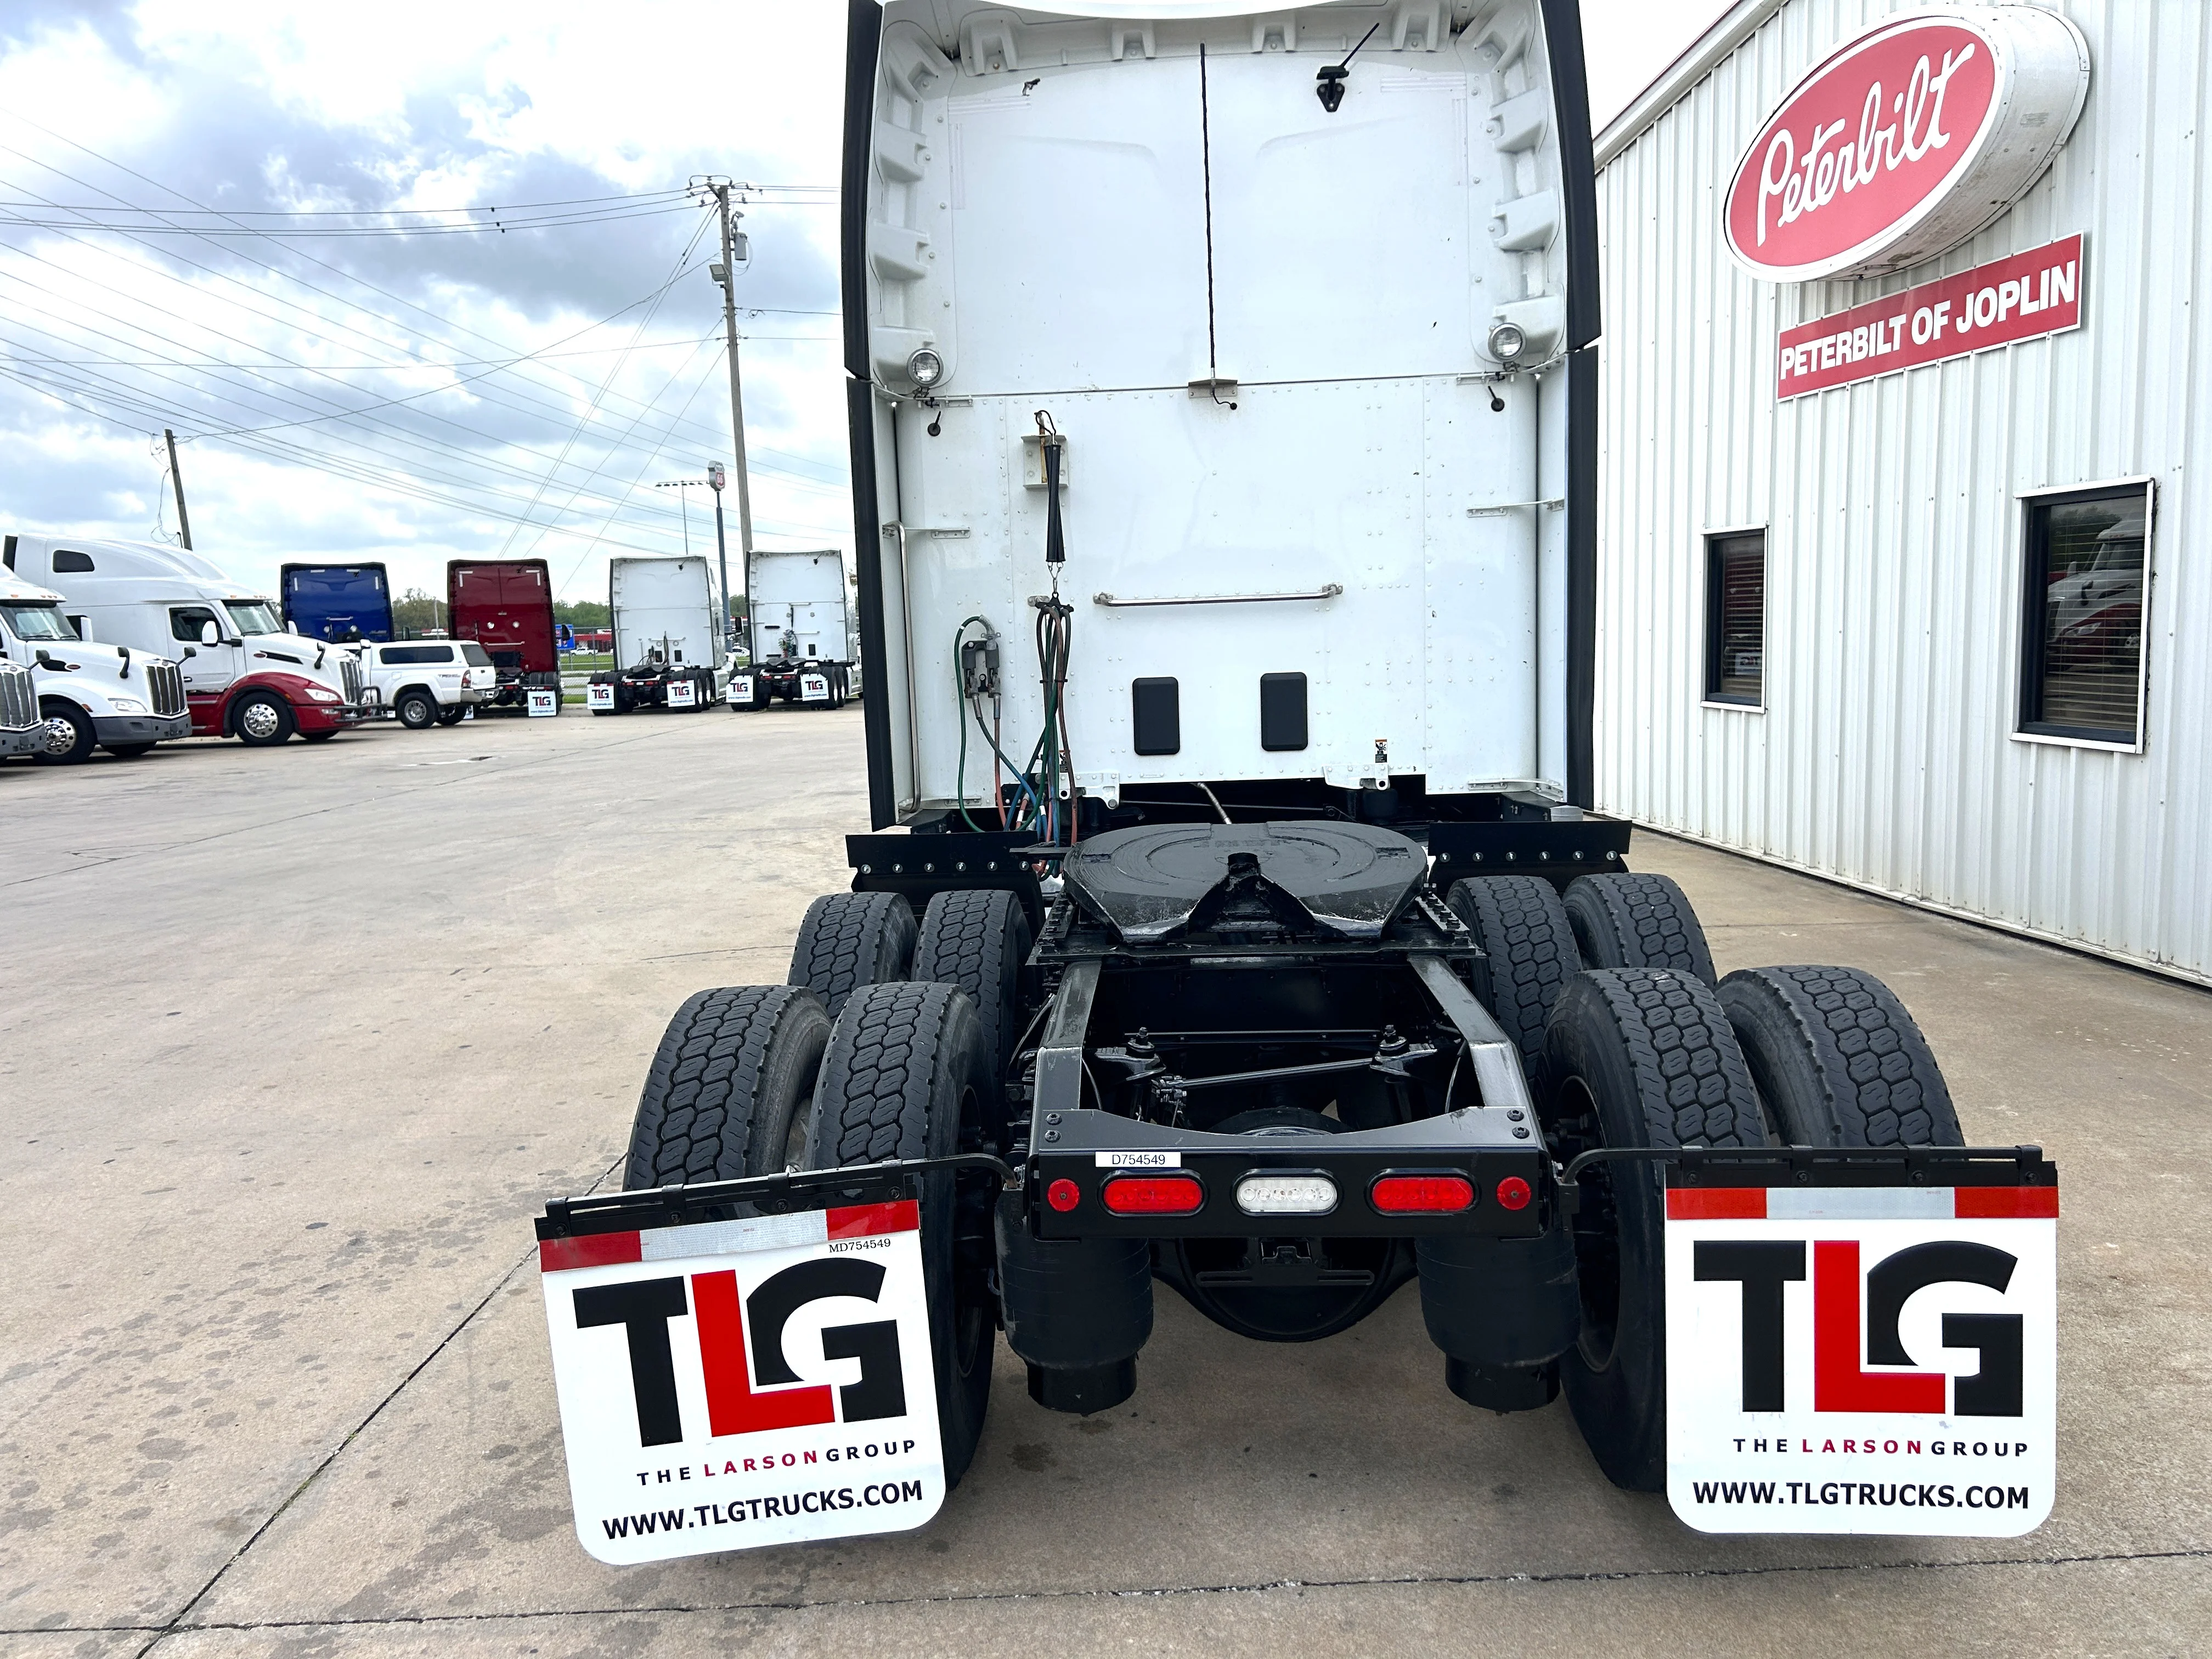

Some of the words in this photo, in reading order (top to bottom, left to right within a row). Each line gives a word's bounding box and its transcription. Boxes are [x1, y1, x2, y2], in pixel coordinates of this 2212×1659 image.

[1757, 42, 1976, 247] Peterbilt
[1780, 312, 1906, 380] PETERBILT
[1910, 300, 1951, 346] OF
[1956, 260, 2076, 334] JOPLIN
[591, 689, 610, 698] TLG
[672, 686, 690, 696] TLG
[731, 682, 748, 692] TLG
[805, 680, 823, 691] TLG
[532, 696, 551, 706] TLG
[1112, 1154, 1165, 1165] D754549
[828, 1238, 891, 1253] MD754549
[1694, 1240, 2023, 1417] TLG
[572, 1257, 907, 1447] TLG
[1733, 1438, 1788, 1453] THE
[1802, 1439, 1921, 1454] LARSON
[1931, 1441, 2028, 1457] GROUP
[637, 1466, 691, 1486] THE
[704, 1451, 817, 1477] LARSON
[826, 1440, 916, 1462] GROUP
[1692, 1482, 2029, 1509] WWW.TLGTRUCKS.COM
[602, 1480, 923, 1540] WWW.TLGTRUCKS.COM
